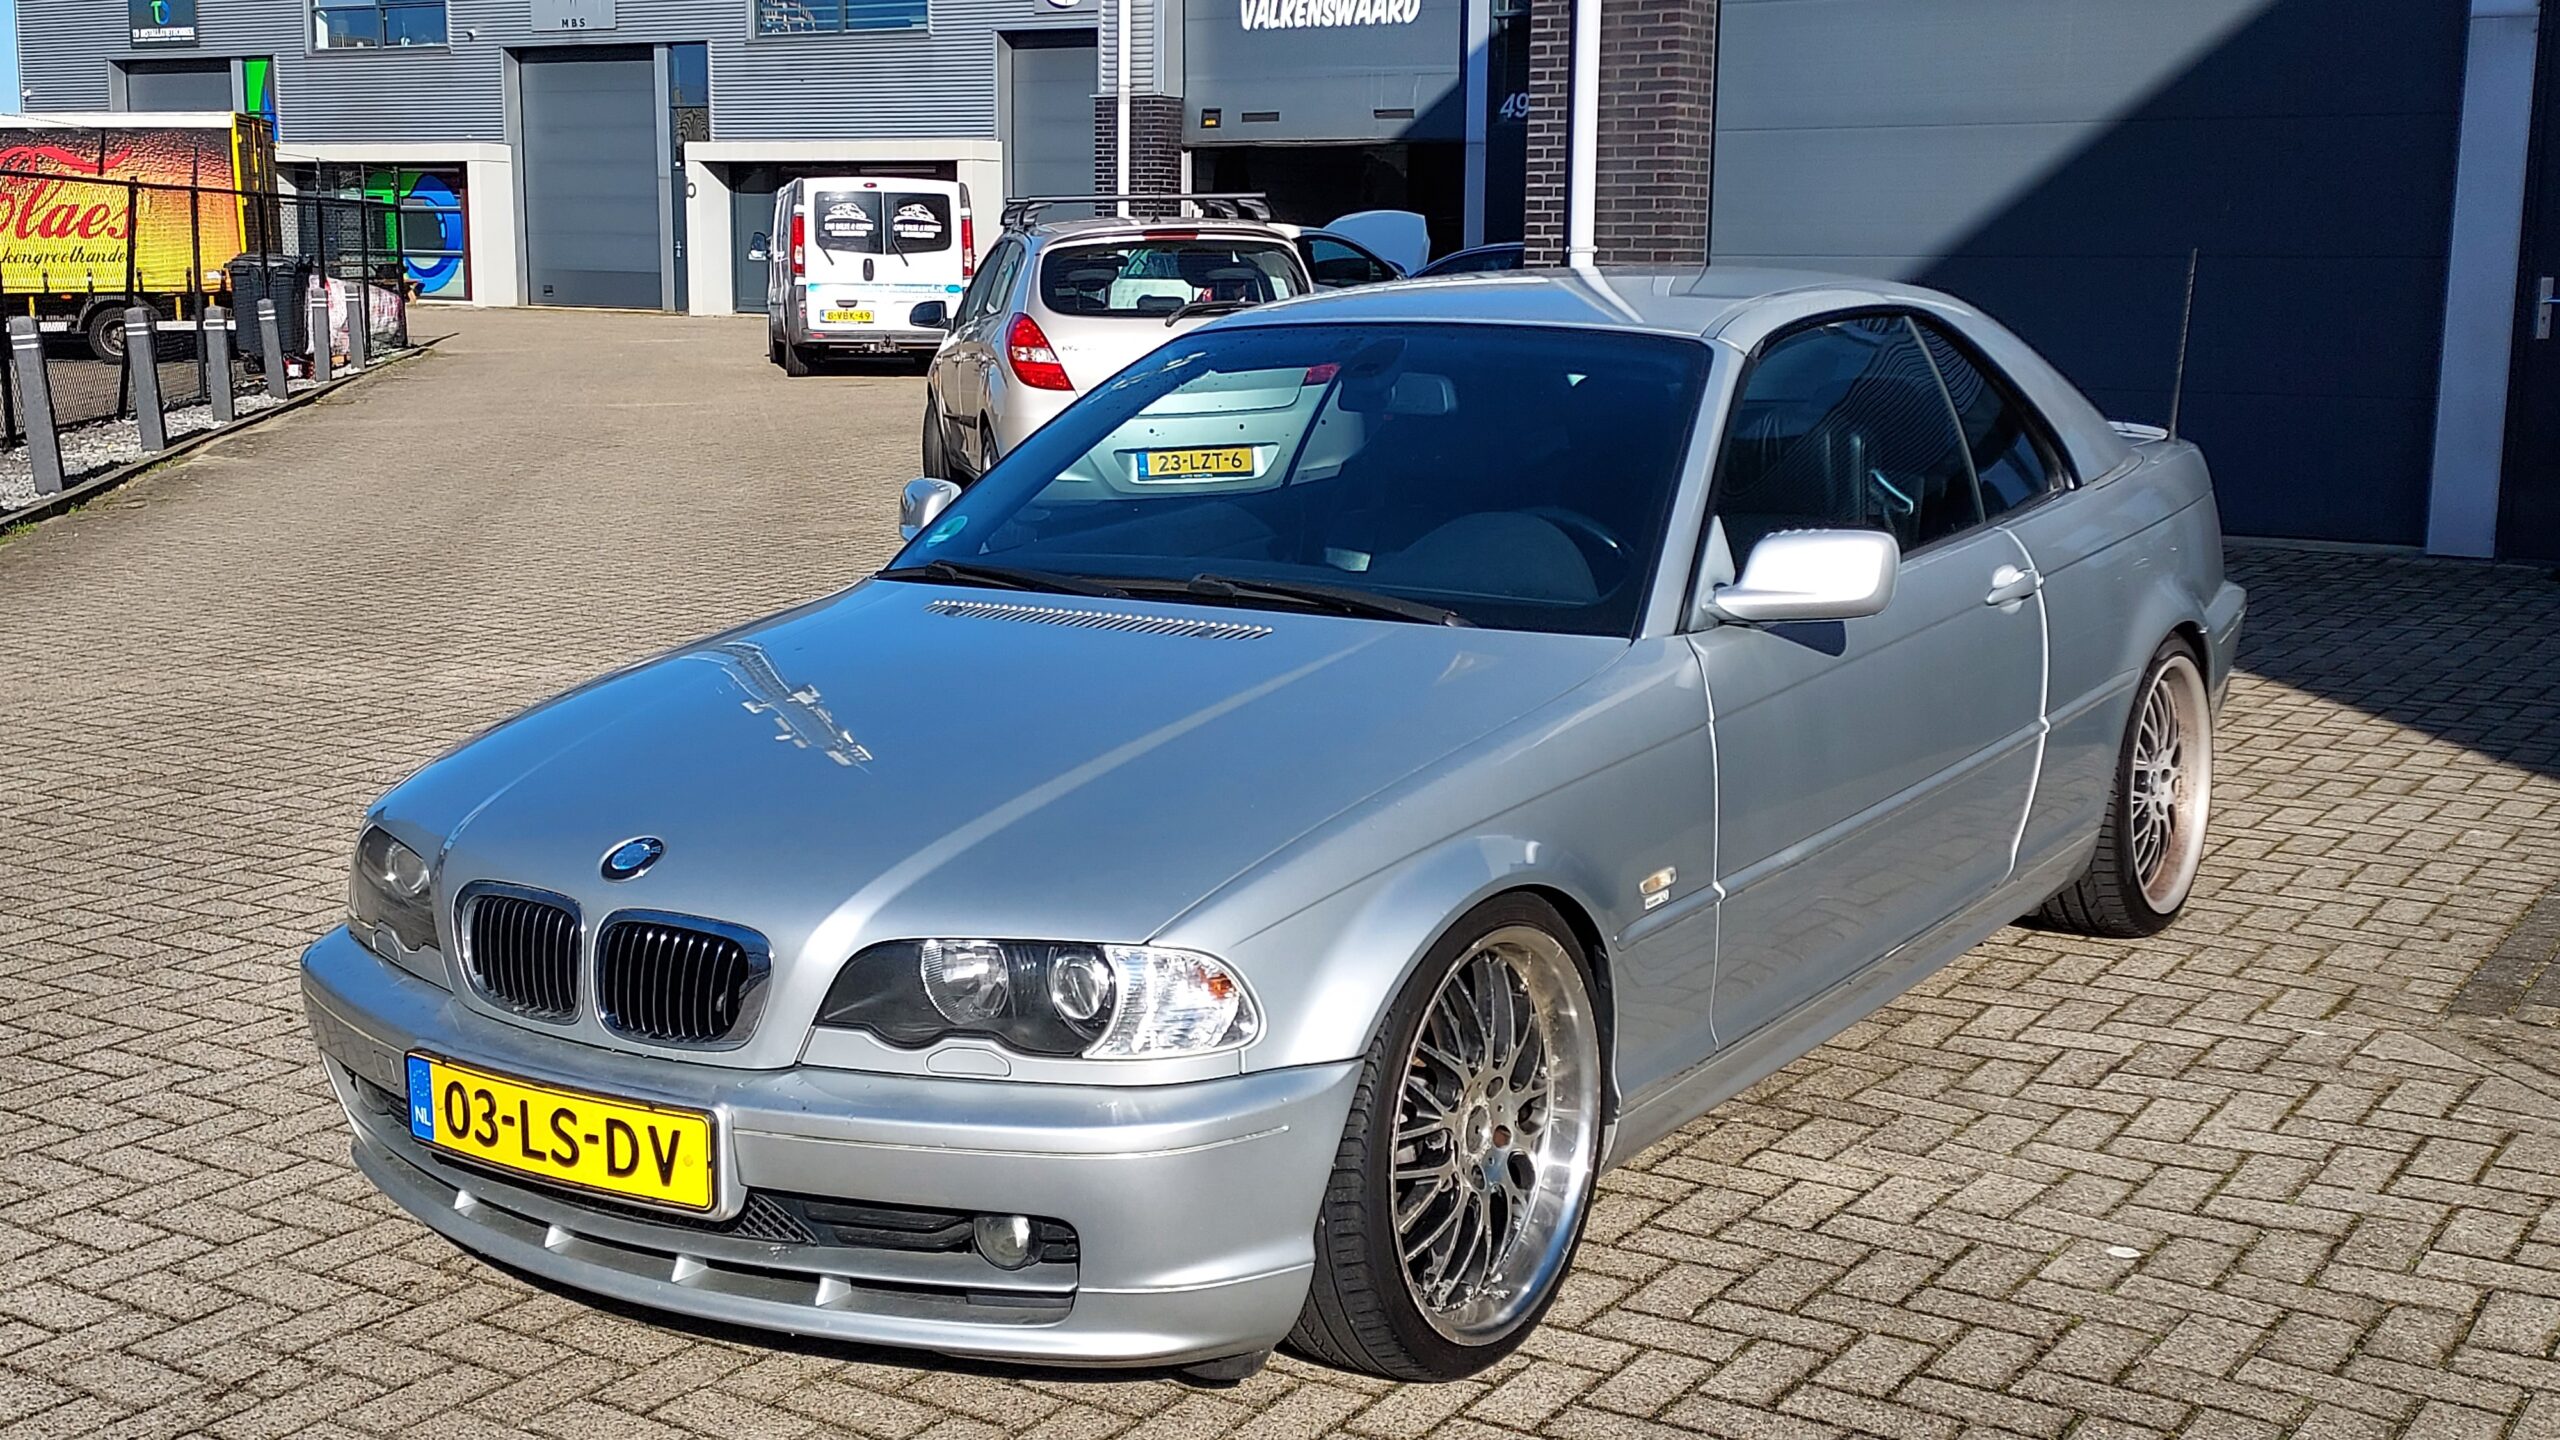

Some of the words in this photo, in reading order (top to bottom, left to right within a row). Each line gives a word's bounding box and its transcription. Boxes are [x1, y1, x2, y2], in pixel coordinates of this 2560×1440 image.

[561, 17, 586, 28] MBS
[1240, 0, 1421, 31] VALKENSWAARD
[1500, 92, 1529, 118] 49
[1158, 451, 1243, 472] 23-LZT-6
[414, 1105, 432, 1126] NL
[445, 1081, 680, 1187] 03-LS-DV
